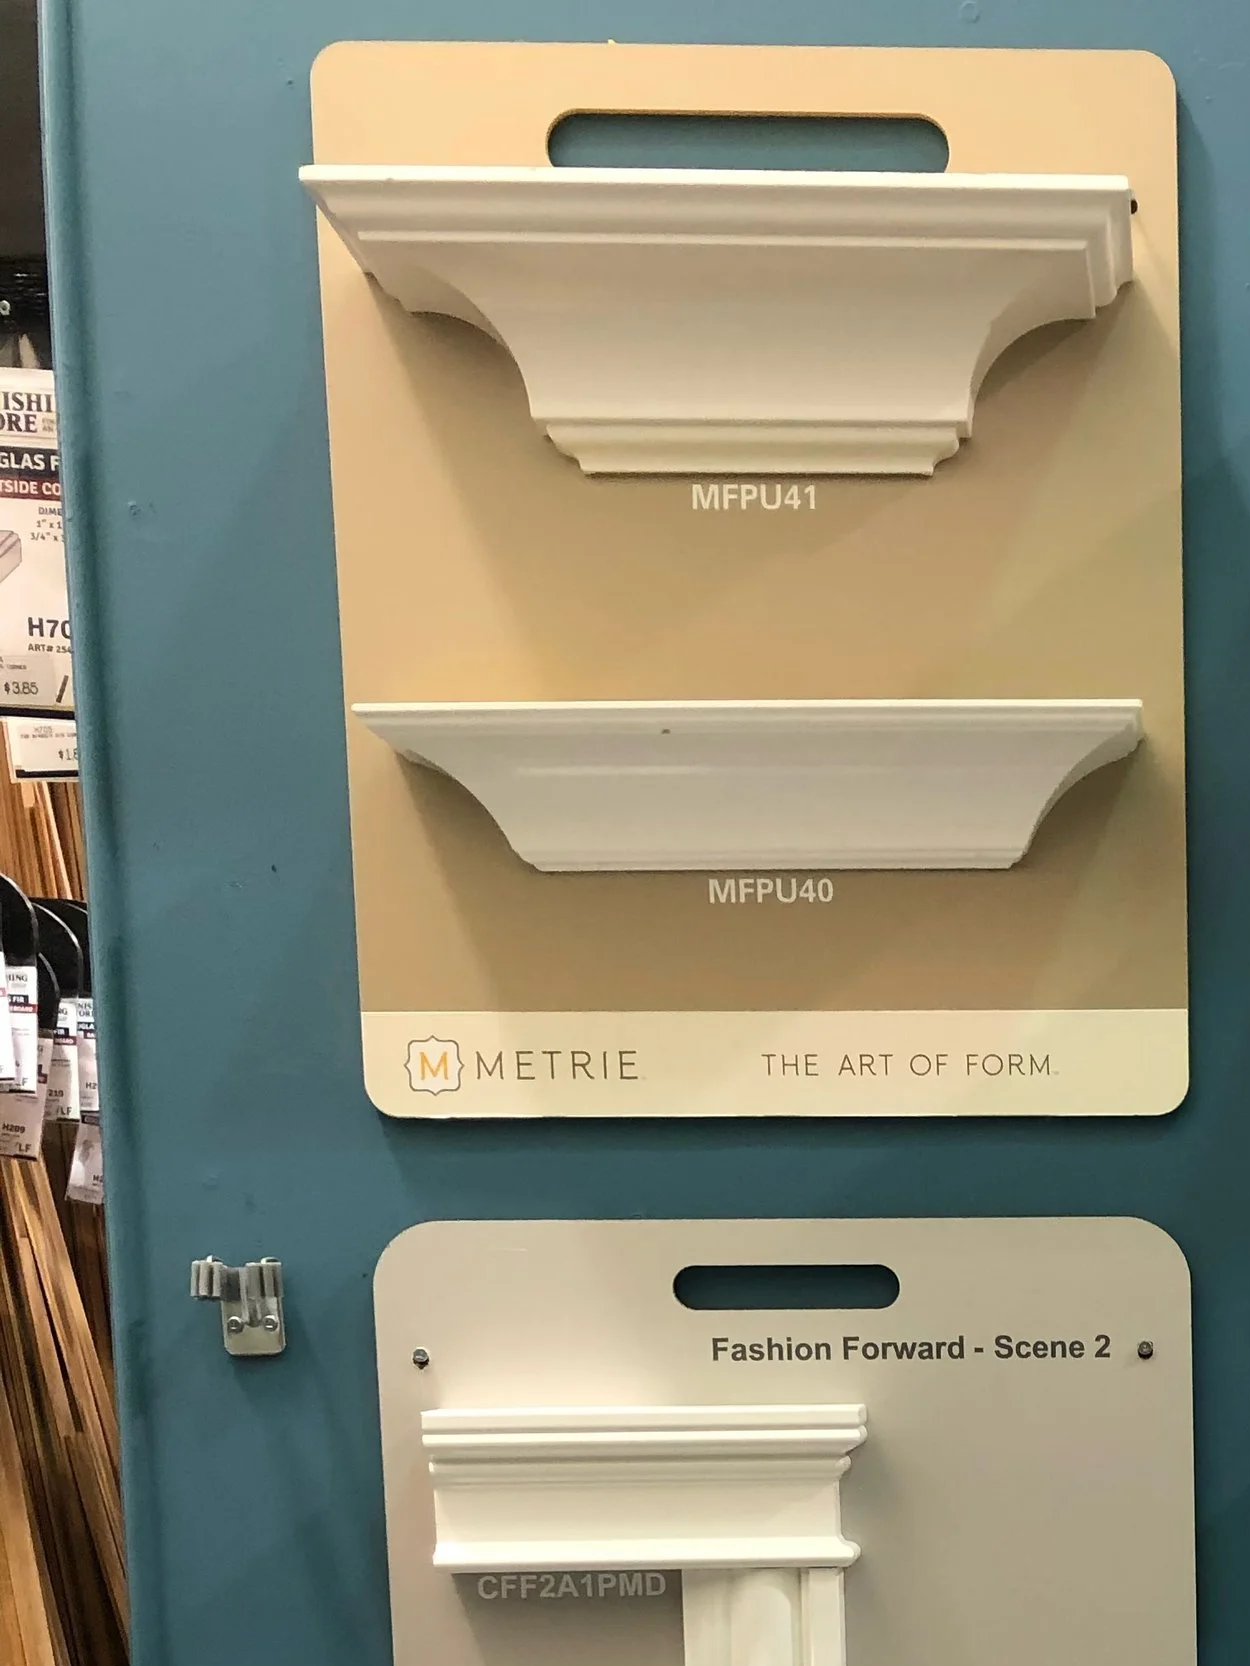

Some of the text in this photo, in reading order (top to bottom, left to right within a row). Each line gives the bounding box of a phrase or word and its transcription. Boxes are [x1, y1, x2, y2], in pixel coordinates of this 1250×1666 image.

[691, 484, 818, 511] MFPU41
[708, 878, 835, 905] MFPU40
[419, 1050, 639, 1081] M METRIE
[761, 1053, 1051, 1077] THE ART OF FORM
[711, 1337, 832, 1362] Fashion
[843, 1335, 965, 1361] Forward
[994, 1335, 1085, 1360] Scene
[1094, 1334, 1112, 1359] 2
[477, 1571, 667, 1600] CFF2A1PMD
